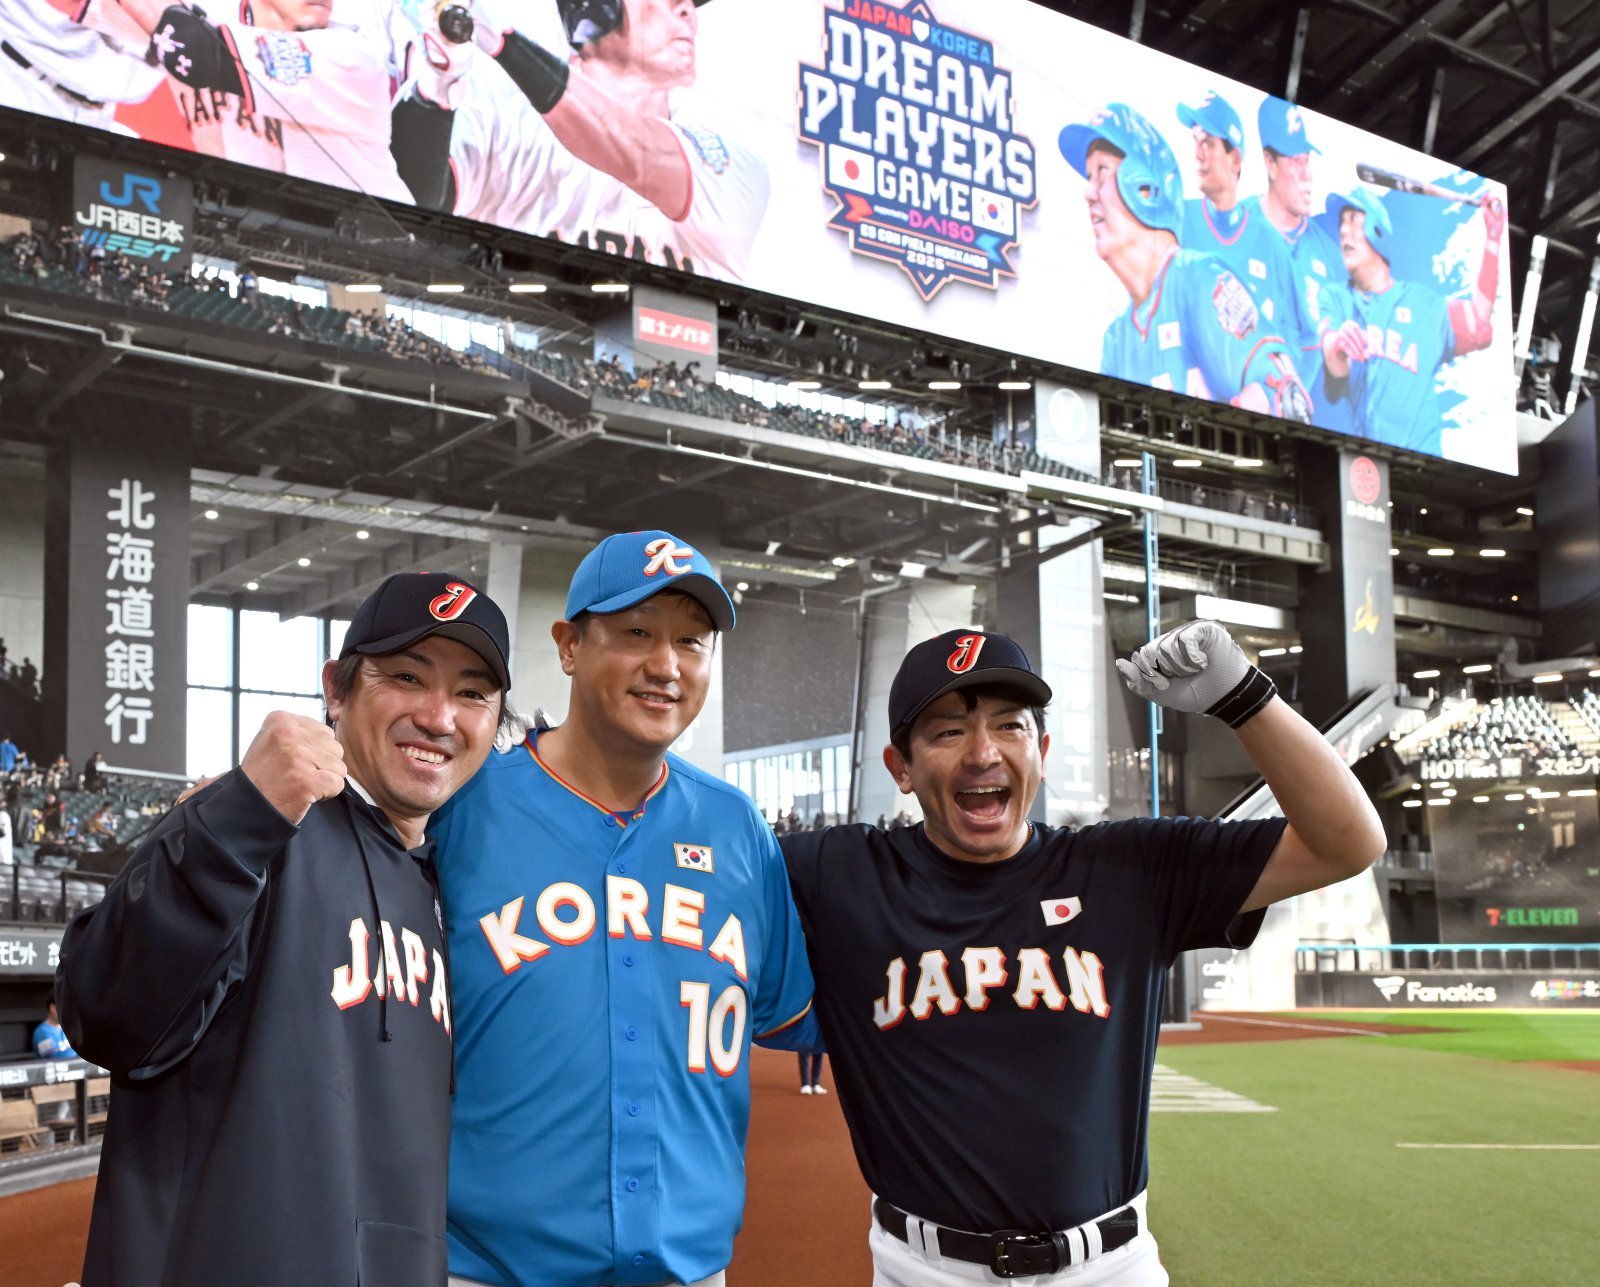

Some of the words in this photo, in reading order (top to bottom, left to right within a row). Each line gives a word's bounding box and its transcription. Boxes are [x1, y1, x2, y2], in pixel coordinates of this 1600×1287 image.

[847, 0, 912, 36] JAPAN
[931, 26, 991, 64] KOREA
[828, 15, 1010, 132] DREAM
[803, 70, 1034, 199] PLAYERS
[100, 172, 162, 215] JR
[876, 159, 971, 222] GAME
[75, 203, 184, 244] JR西日本
[908, 209, 975, 243] DAISO
[906, 249, 945, 271] 2025
[643, 538, 694, 577] K
[105, 477, 155, 745] 北海道銀行
[428, 581, 478, 622] J
[946, 634, 987, 675] J
[479, 875, 748, 983] KOREA
[872, 946, 1112, 1031] JAPAN
[1406, 981, 1498, 1002] Fanatics
[680, 981, 747, 1078] 10
